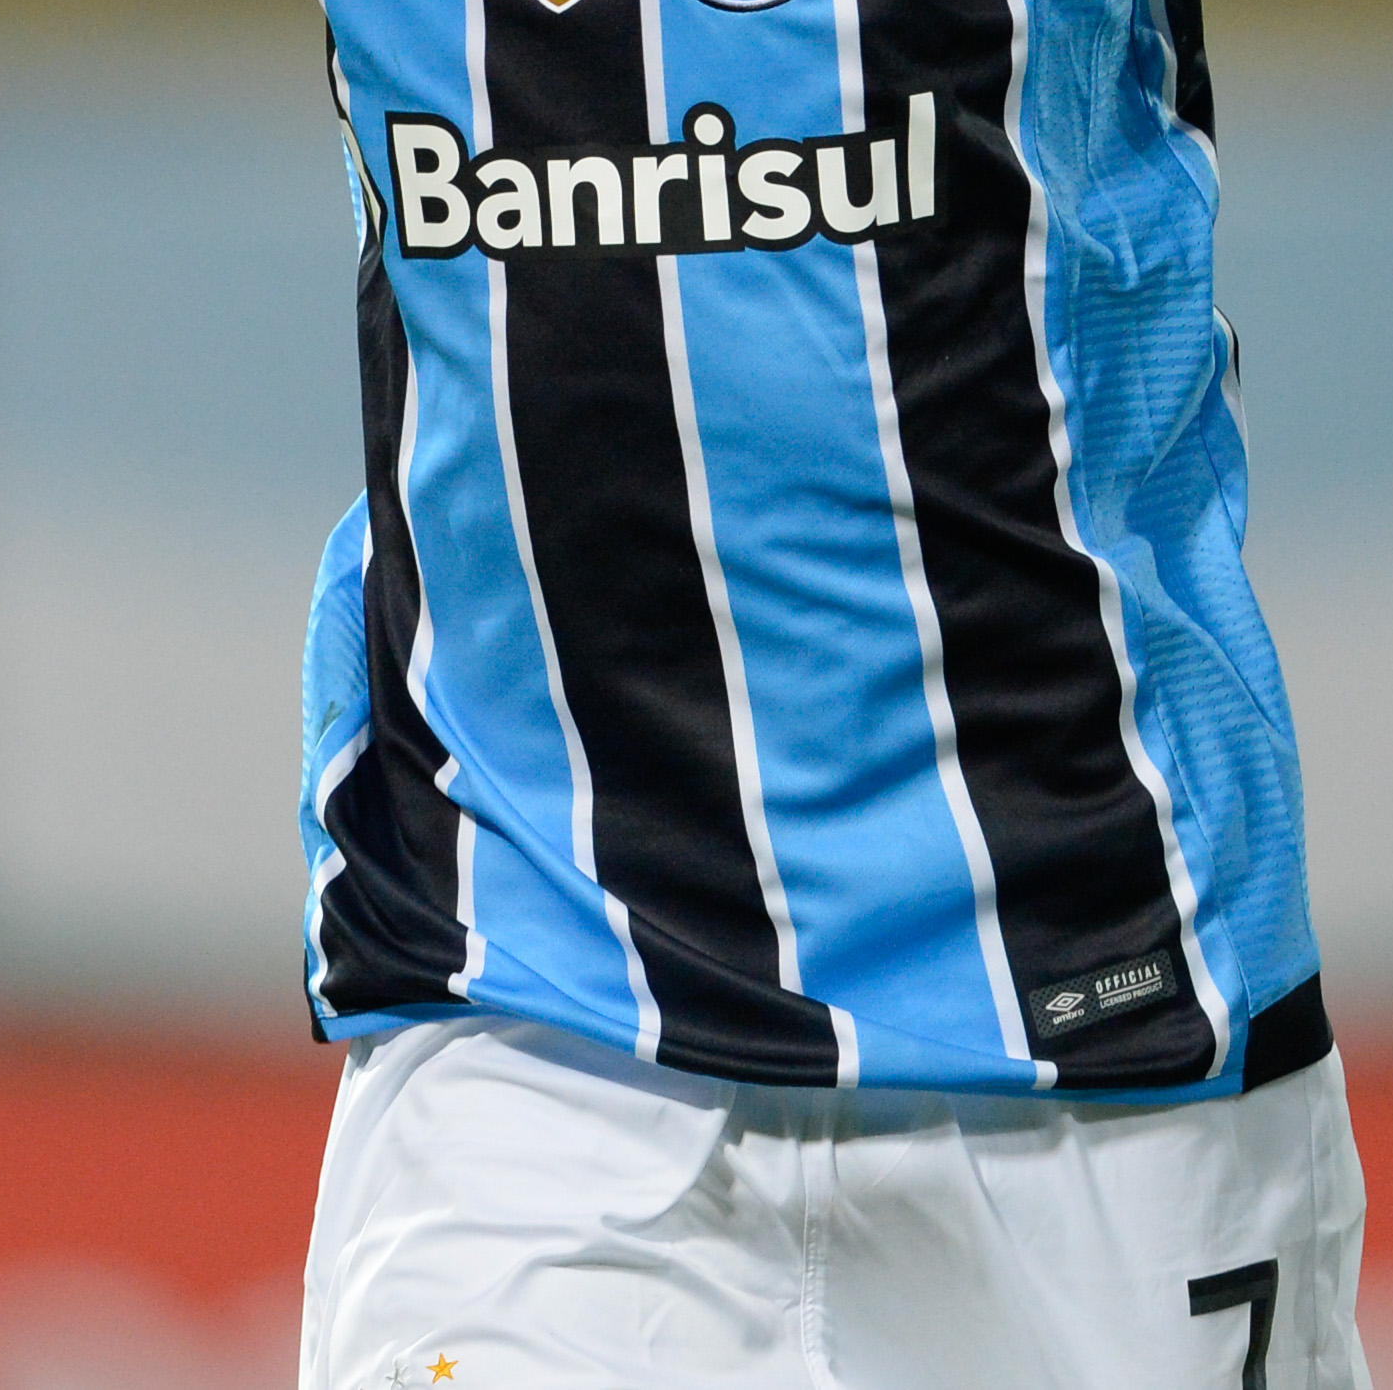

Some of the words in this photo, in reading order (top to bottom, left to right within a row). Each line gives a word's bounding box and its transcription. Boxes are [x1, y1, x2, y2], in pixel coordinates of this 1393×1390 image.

[392, 92, 935, 249] Banrisul
[1095, 962, 1160, 993] OFFICIAL
[1100, 992, 1133, 1009] LICENSED
[1132, 981, 1163, 999] PRODUCT
[1052, 1008, 1084, 1024] umbro
[1187, 1257, 1279, 1390] 7
